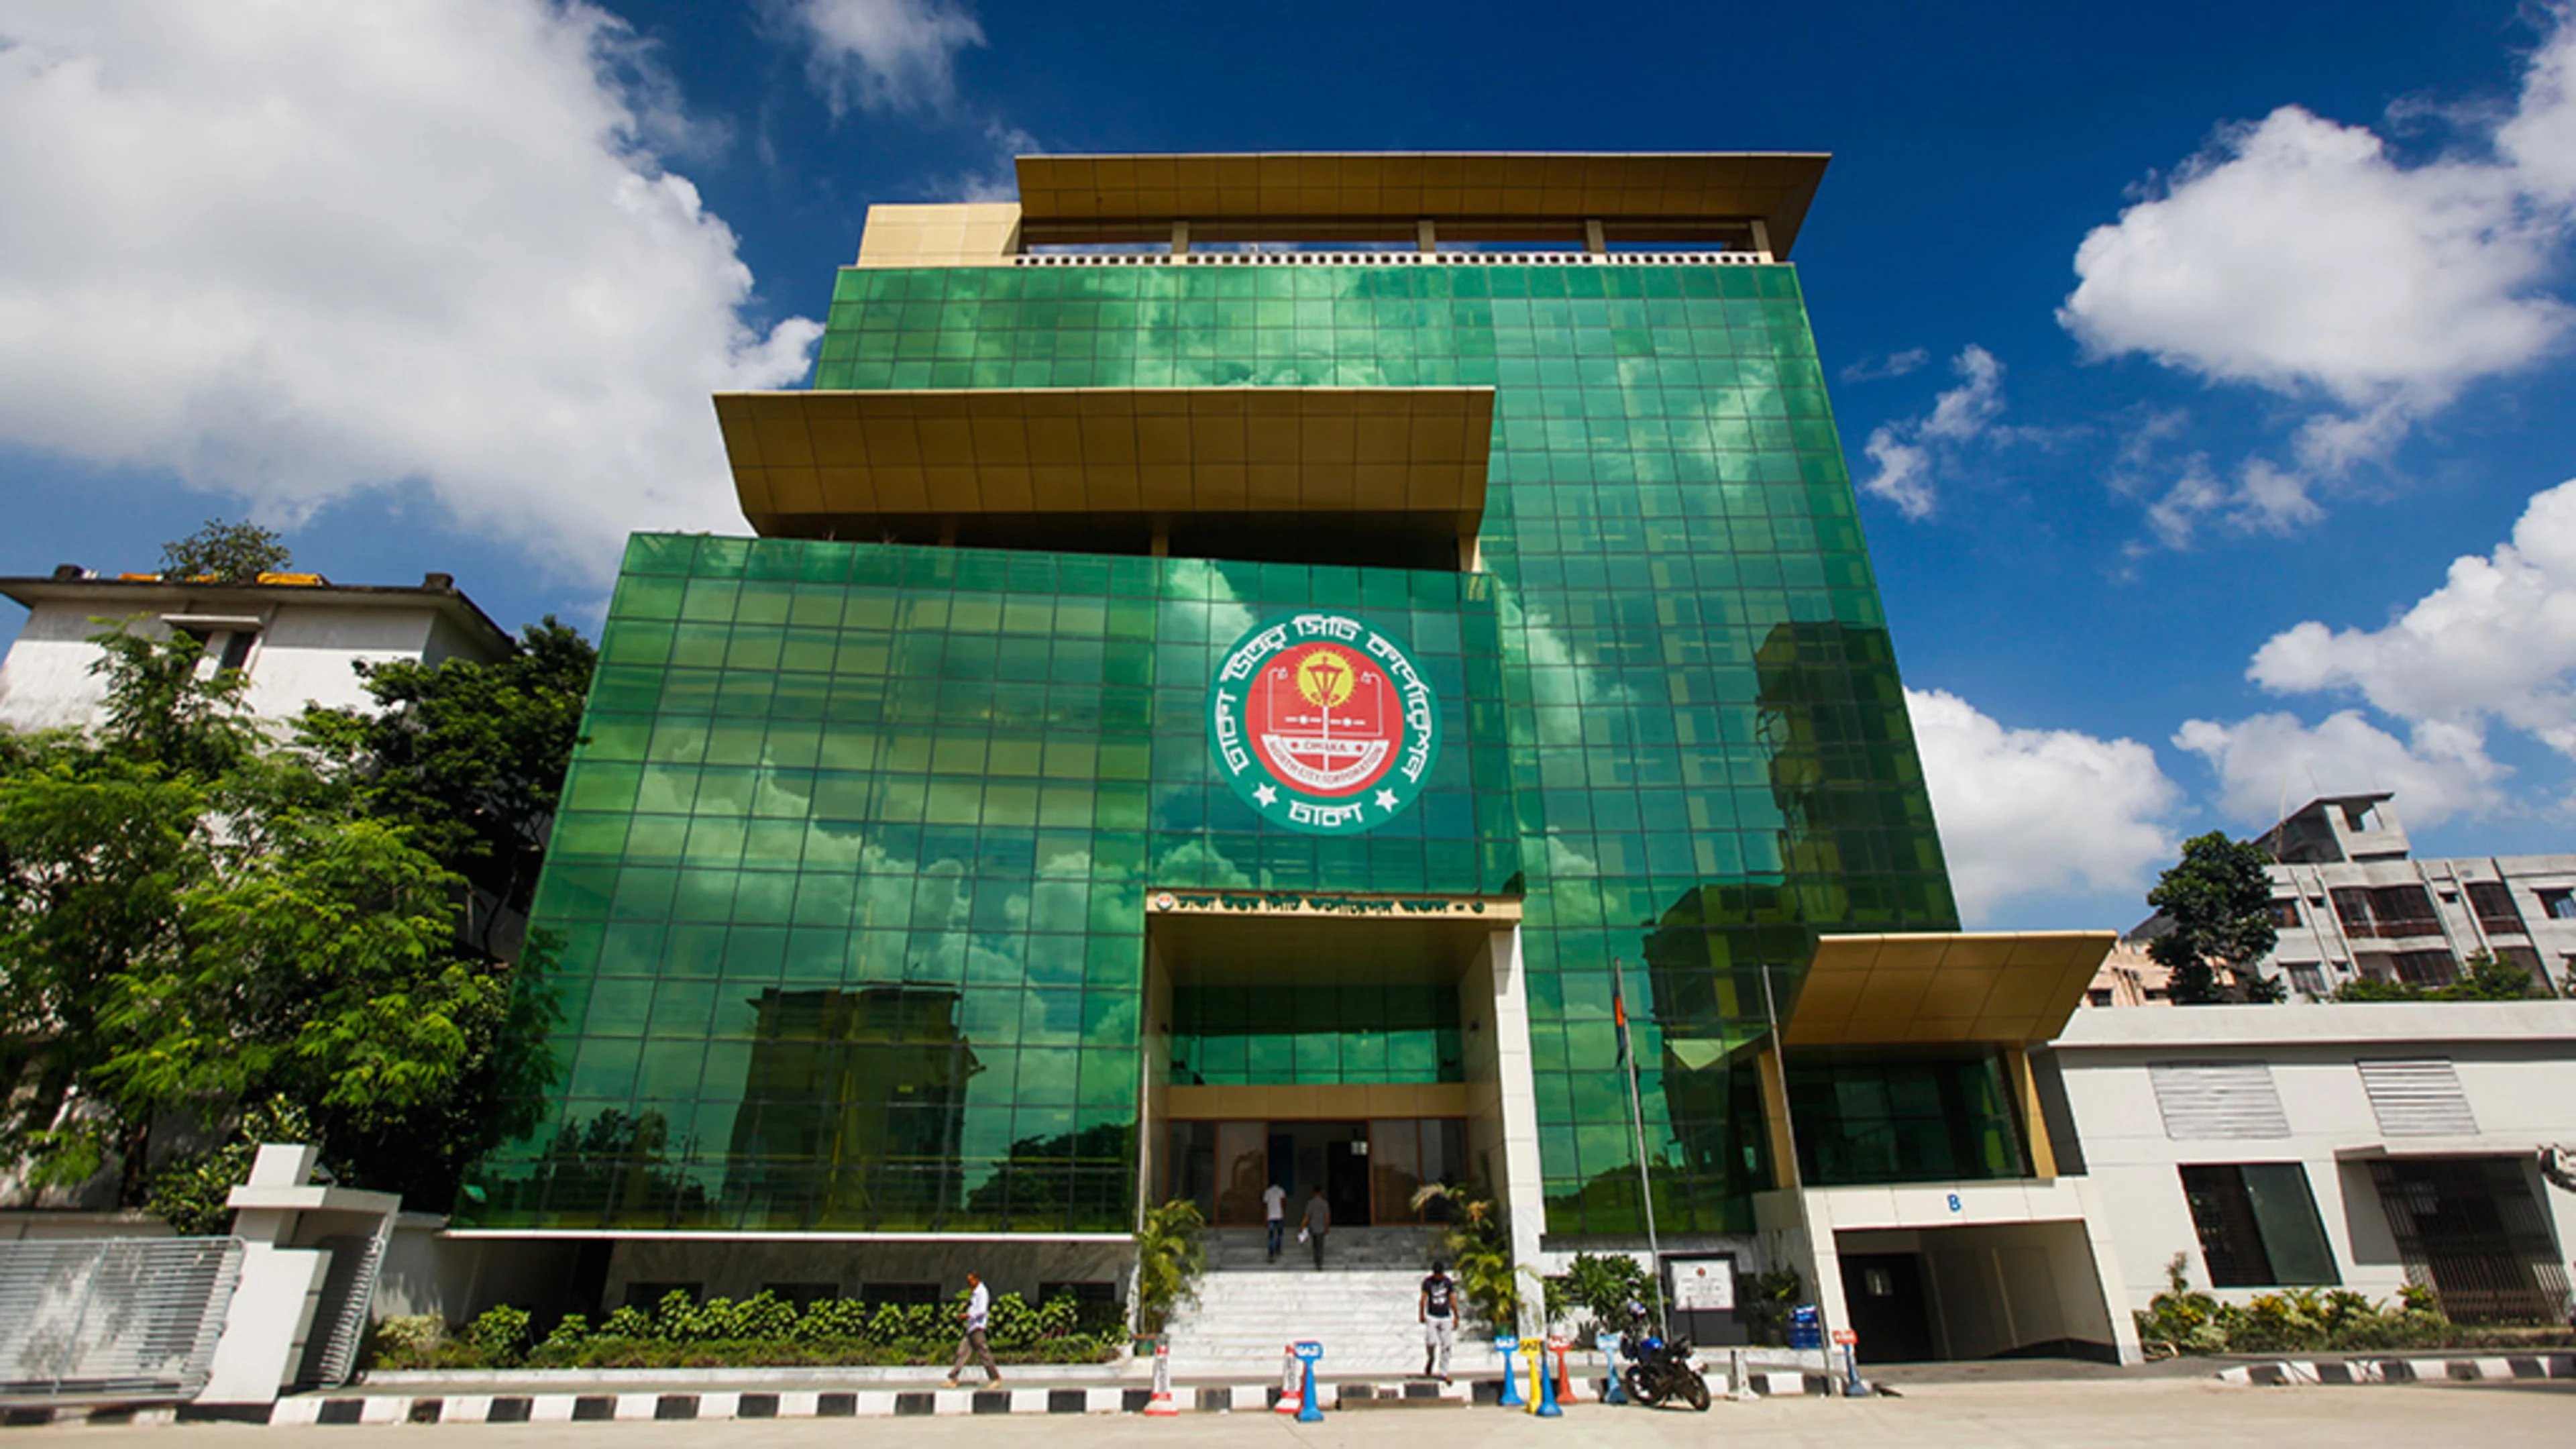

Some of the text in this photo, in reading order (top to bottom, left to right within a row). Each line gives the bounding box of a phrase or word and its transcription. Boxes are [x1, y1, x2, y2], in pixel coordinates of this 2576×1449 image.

[1291, 613, 1363, 642] সিটি
[1220, 623, 1288, 682] উত্তর
[1215, 688, 1250, 776] ঢাকা
[1288, 799, 1364, 826] ঢাকা
[1947, 1193, 1962, 1212] B
